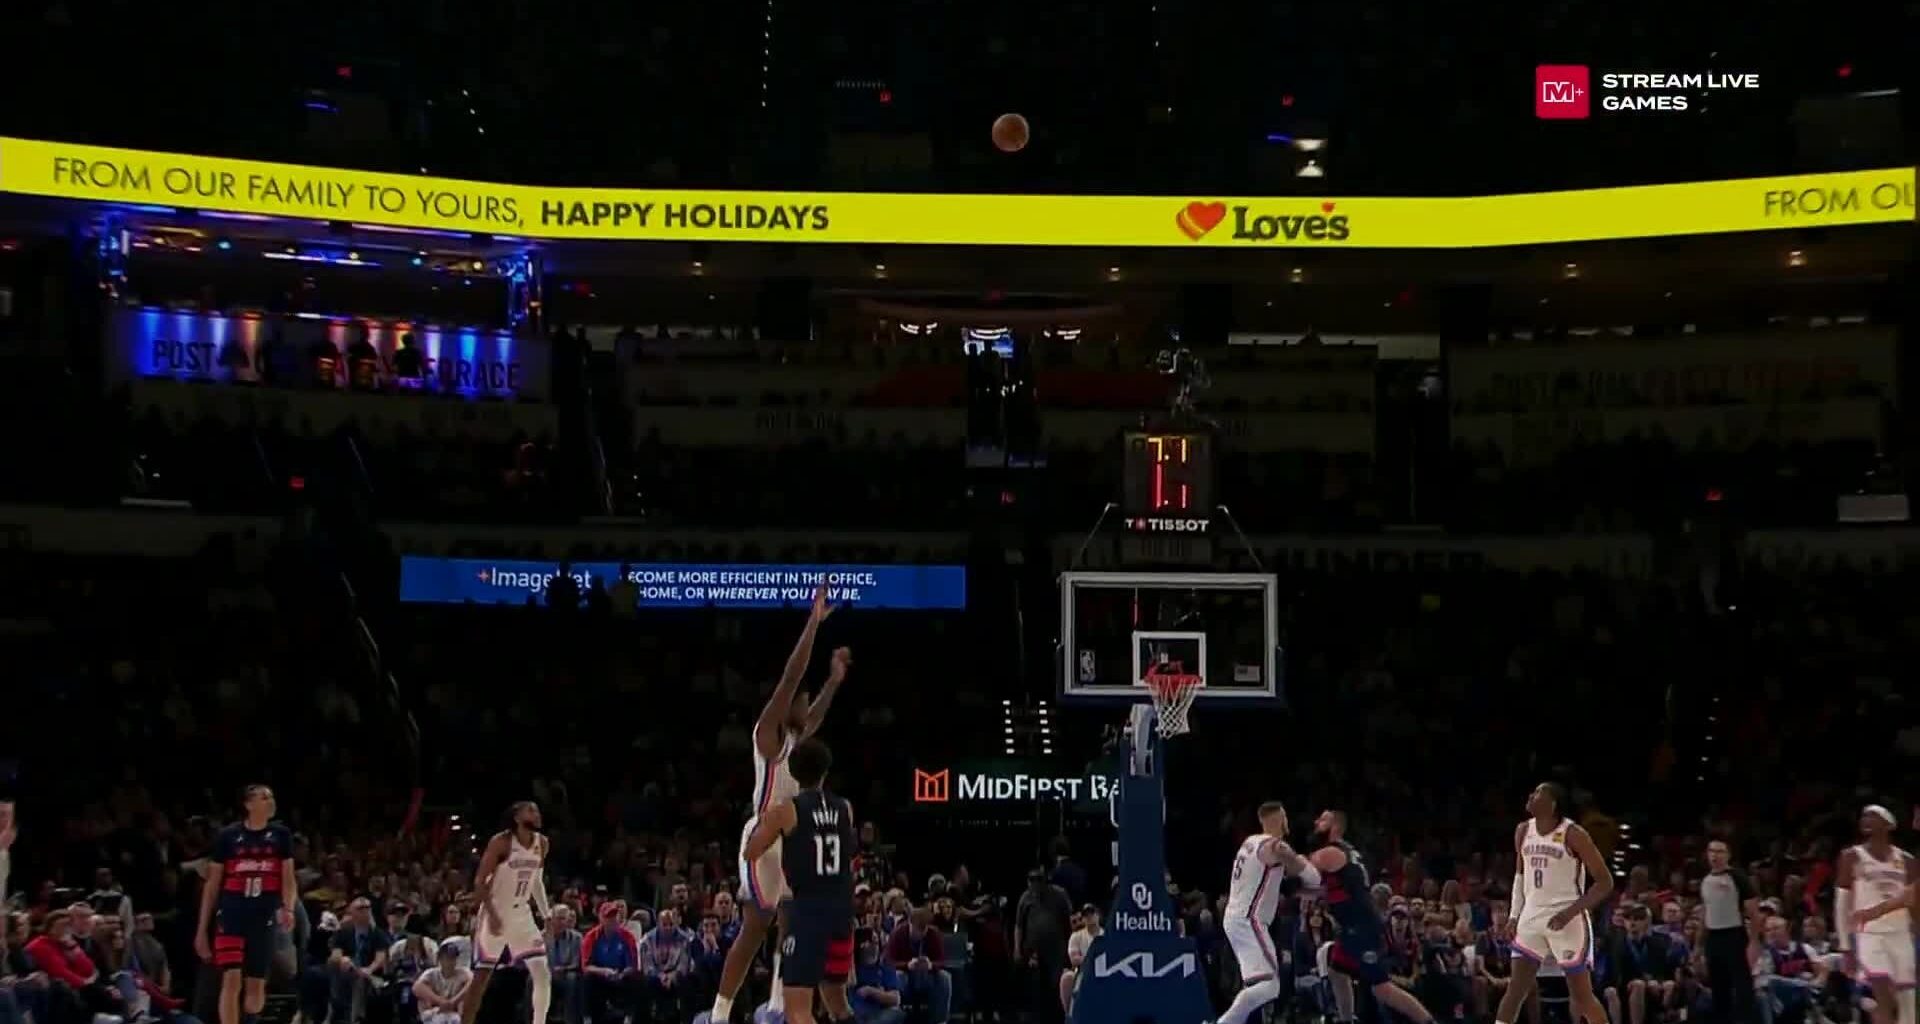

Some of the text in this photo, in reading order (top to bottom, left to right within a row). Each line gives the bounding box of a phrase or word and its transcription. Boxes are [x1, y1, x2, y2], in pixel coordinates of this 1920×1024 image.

[53, 157, 829, 231] FROM OUR FAMILY TO YOURS, HAPPY HOLIDAYS
[1764, 187, 1860, 217] FROM
[1148, 518, 1210, 532] TISSOT
[491, 567, 592, 592] Imageet
[678, 572, 718, 584] MORE
[720, 572, 782, 585] EFFICIENT
[785, 573, 798, 585] IN
[802, 573, 826, 585] THE
[828, 573, 877, 587] OFFICE,
[685, 587, 704, 599] OR
[708, 588, 778, 600] WHEREVER
[782, 588, 809, 600] YOU
[812, 588, 839, 600] AY
[842, 588, 861, 600] BE.
[814, 834, 841, 876] 13
[1534, 869, 1543, 889] 8
[1132, 882, 1153, 910] OU
[1116, 911, 1172, 931] Health
[1094, 952, 1196, 978] KIA
